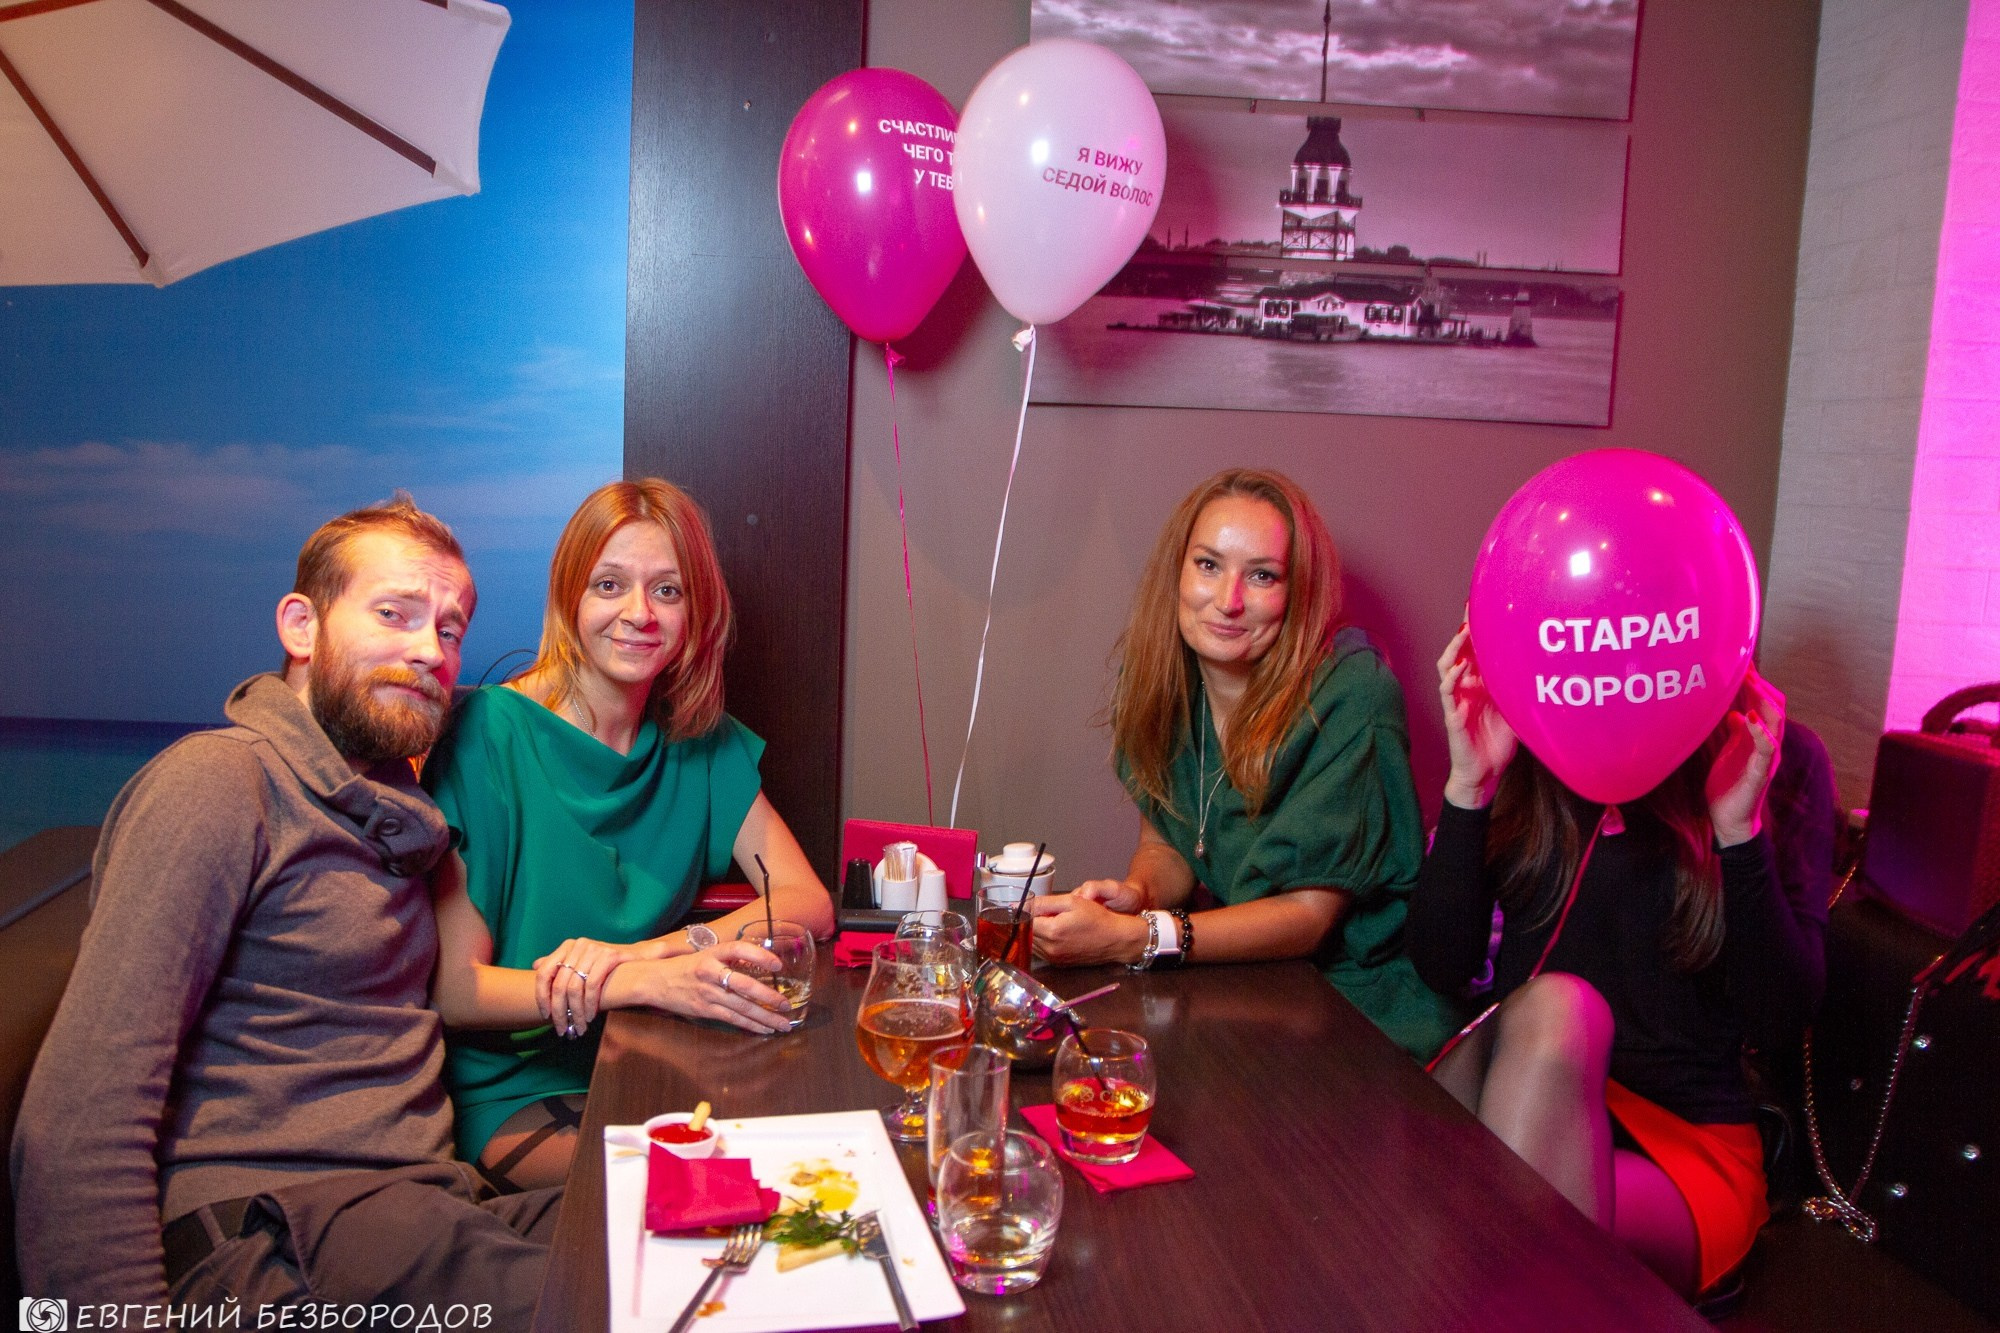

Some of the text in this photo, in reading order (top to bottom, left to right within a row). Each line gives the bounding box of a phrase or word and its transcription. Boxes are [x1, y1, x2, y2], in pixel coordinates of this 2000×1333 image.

[879, 119, 957, 144] СЧАСТЛИ
[903, 142, 944, 163] ЧЕГО
[1077, 147, 1143, 176] Я ВИЖУ
[914, 168, 925, 185] У
[1042, 167, 1153, 207] СЕДОЙ ВОЛОС
[1538, 606, 1700, 653] СТАРАЯ
[1535, 663, 1707, 707] КОРОВА
